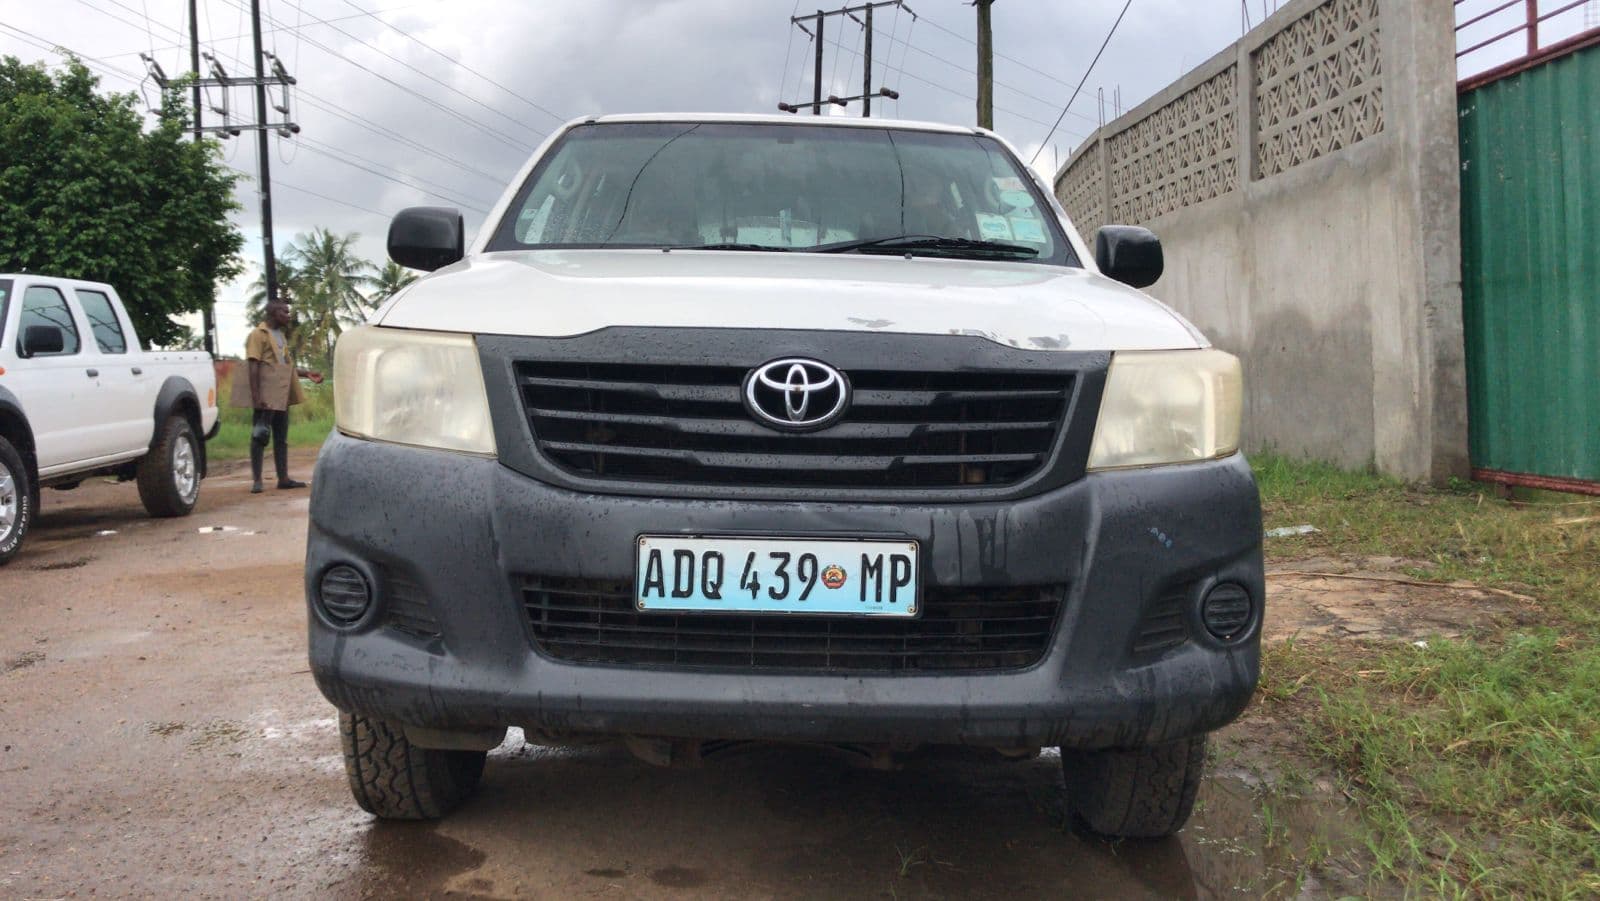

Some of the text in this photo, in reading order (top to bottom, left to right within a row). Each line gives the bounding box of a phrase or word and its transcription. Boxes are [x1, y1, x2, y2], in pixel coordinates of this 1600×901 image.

[642, 549, 912, 603] ADQ 439 MP
